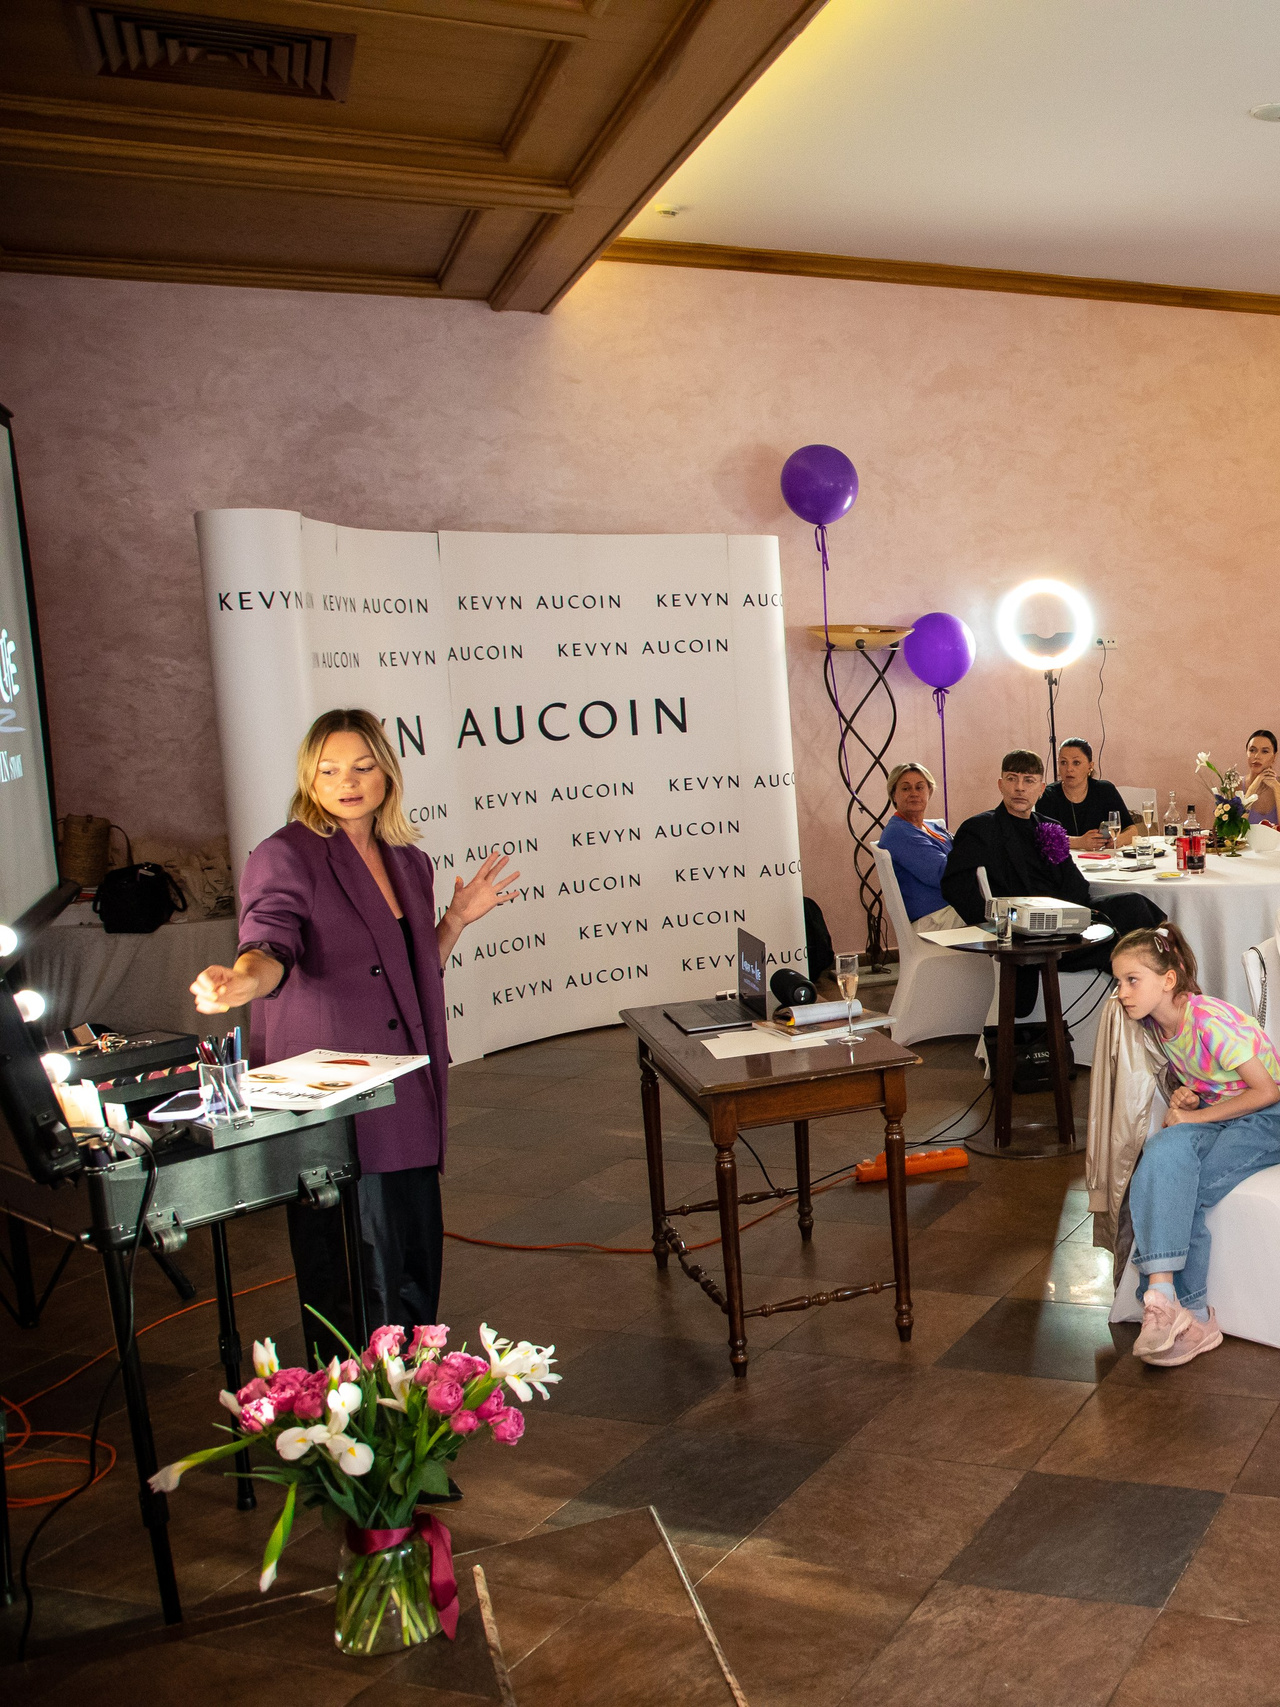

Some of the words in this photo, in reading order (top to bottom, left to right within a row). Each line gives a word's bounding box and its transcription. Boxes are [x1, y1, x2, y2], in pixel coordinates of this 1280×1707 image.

[218, 591, 303, 611] KEVYN
[323, 595, 356, 613] KEVYN
[363, 598, 428, 614] AUCOIN
[458, 596, 522, 610] KEVYN
[536, 595, 620, 609] AUCOIN
[657, 593, 728, 607] KEVYN
[322, 652, 359, 668] AUCOIN
[379, 650, 435, 667] KEVYN
[448, 645, 522, 661] AUCOIN
[558, 642, 627, 657] KEVYN
[642, 639, 728, 654] AUCOIN
[457, 697, 687, 749] AUCOIN
[410, 804, 447, 823] COIN
[475, 790, 537, 810] KEVYN
[551, 782, 633, 801] AUCOIN
[669, 775, 739, 791] KEVYN
[572, 828, 640, 847] KEVYN
[655, 820, 739, 839] AUCOIN
[496, 886, 545, 906] EVYN
[558, 874, 640, 896] AUCOIN
[676, 865, 745, 882] KEVYN
[475, 933, 545, 961] AUCOIN
[580, 919, 647, 940] KEVYN
[662, 909, 745, 930] AUCOIN
[493, 979, 552, 1005] KEVYN
[566, 964, 648, 989] AUCOIN
[682, 954, 735, 971] KEVY
